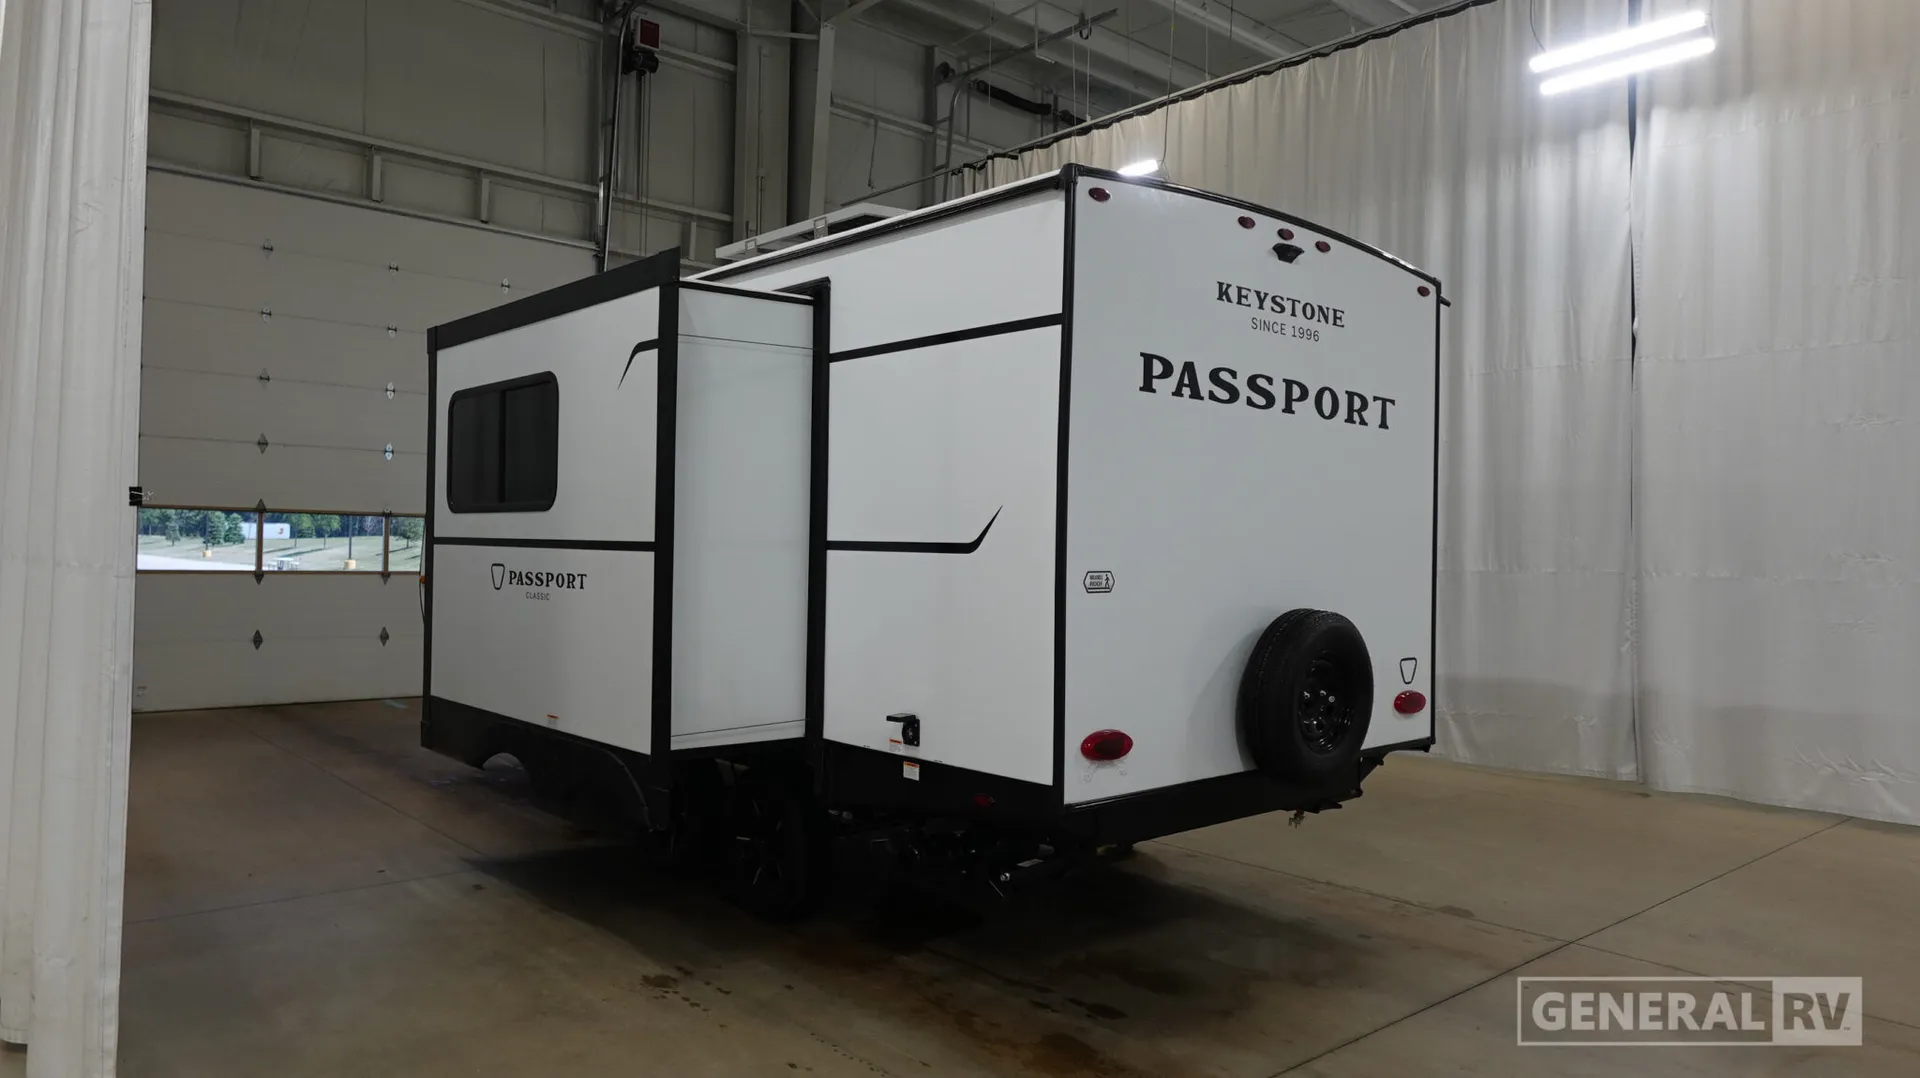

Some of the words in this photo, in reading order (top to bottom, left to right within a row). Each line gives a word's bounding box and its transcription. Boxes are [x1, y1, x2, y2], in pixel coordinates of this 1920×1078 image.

[1216, 281, 1345, 328] KEYSTONE
[1250, 317, 1286, 336] SINCE
[1291, 325, 1320, 343] 1996
[1138, 351, 1396, 430] PASSPORT
[508, 570, 587, 589] PASSPORT
[525, 592, 550, 601] CLASSIC
